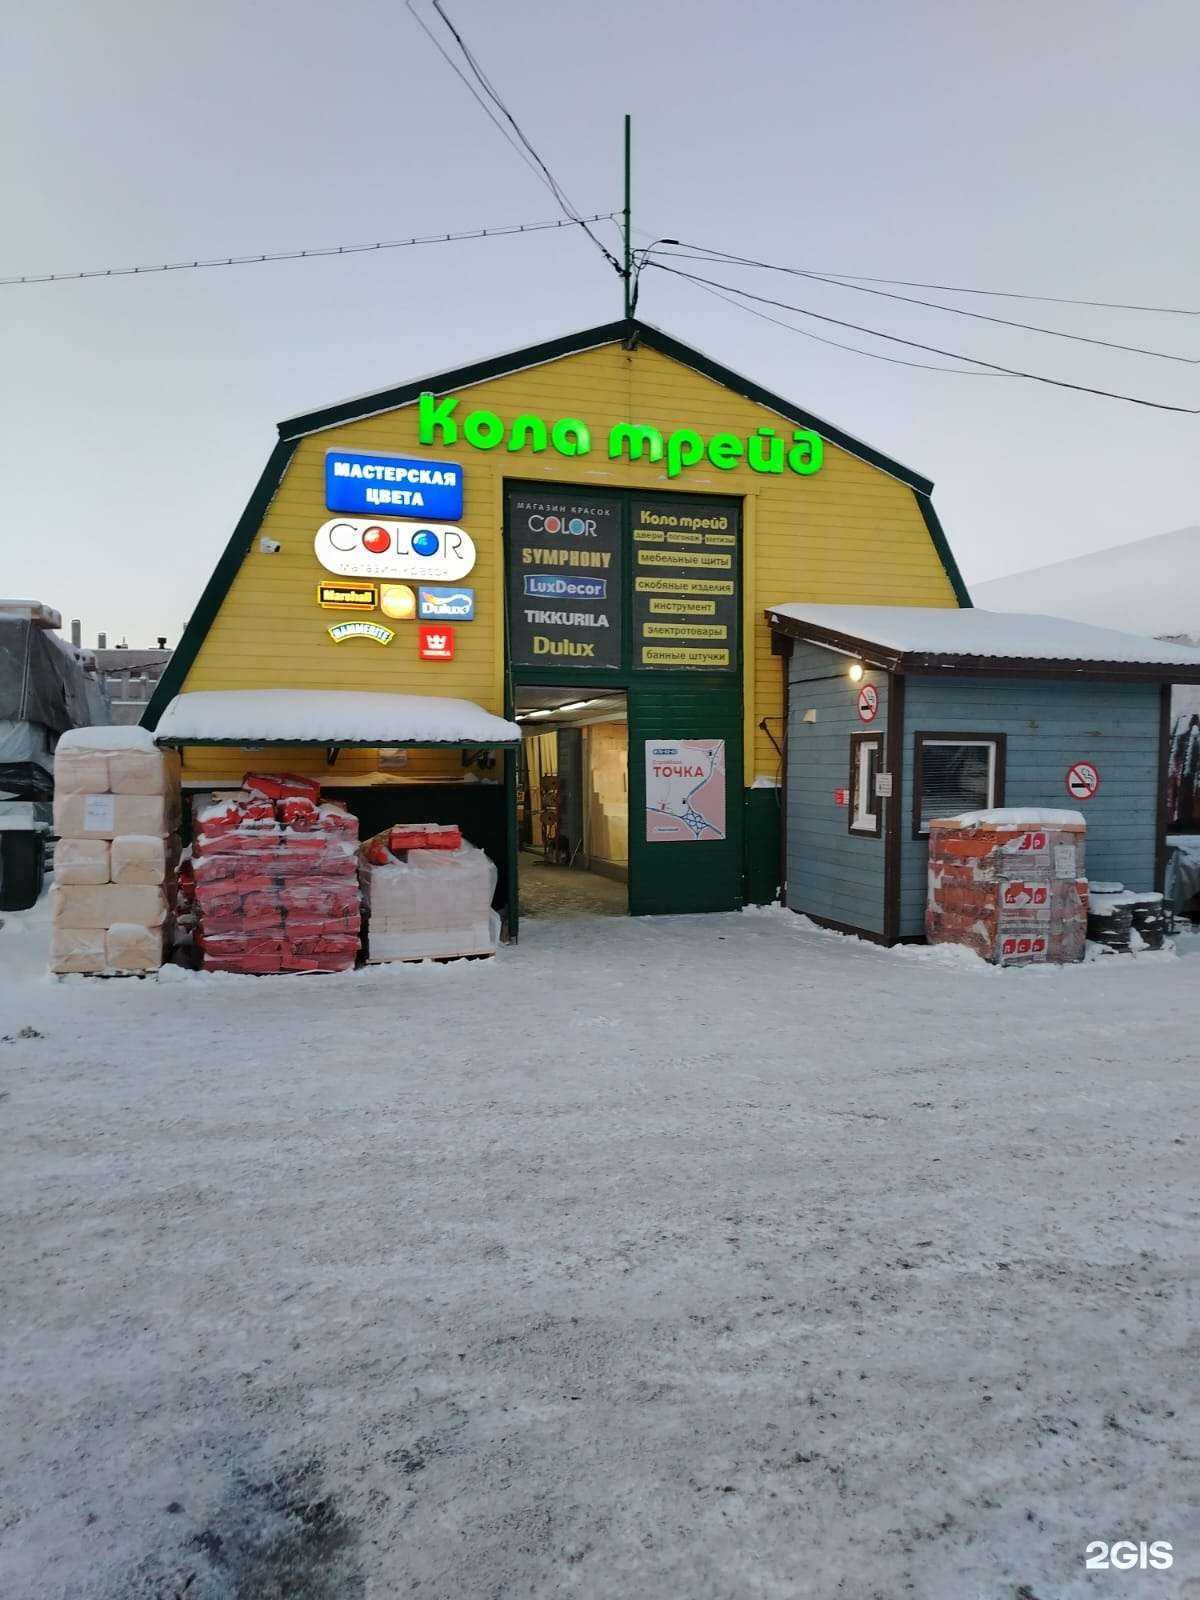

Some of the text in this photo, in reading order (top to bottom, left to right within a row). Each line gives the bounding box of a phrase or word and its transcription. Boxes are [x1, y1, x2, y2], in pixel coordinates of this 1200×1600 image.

[419, 392, 824, 478] Кола трейд
[334, 462, 456, 486] МАСТЕРСКАЯ
[366, 488, 424, 506] ЦВЕТА
[516, 502, 611, 517] МАГАЗИН КРАСОК
[528, 514, 597, 537] COLOR
[640, 510, 727, 531] Кола трейд
[329, 523, 463, 560] COLOR
[522, 547, 612, 568] SYMPHONY
[640, 553, 729, 568] мебельные щиты
[530, 578, 602, 595] LuxDecor
[638, 580, 731, 594] скобяные изделия
[653, 601, 712, 613] инструмент
[524, 610, 610, 628] TIKKURILA
[648, 625, 722, 637] электротовары
[533, 636, 595, 657] Dulux
[646, 649, 725, 663] банные штучки
[653, 766, 705, 778] ТОЧКА
